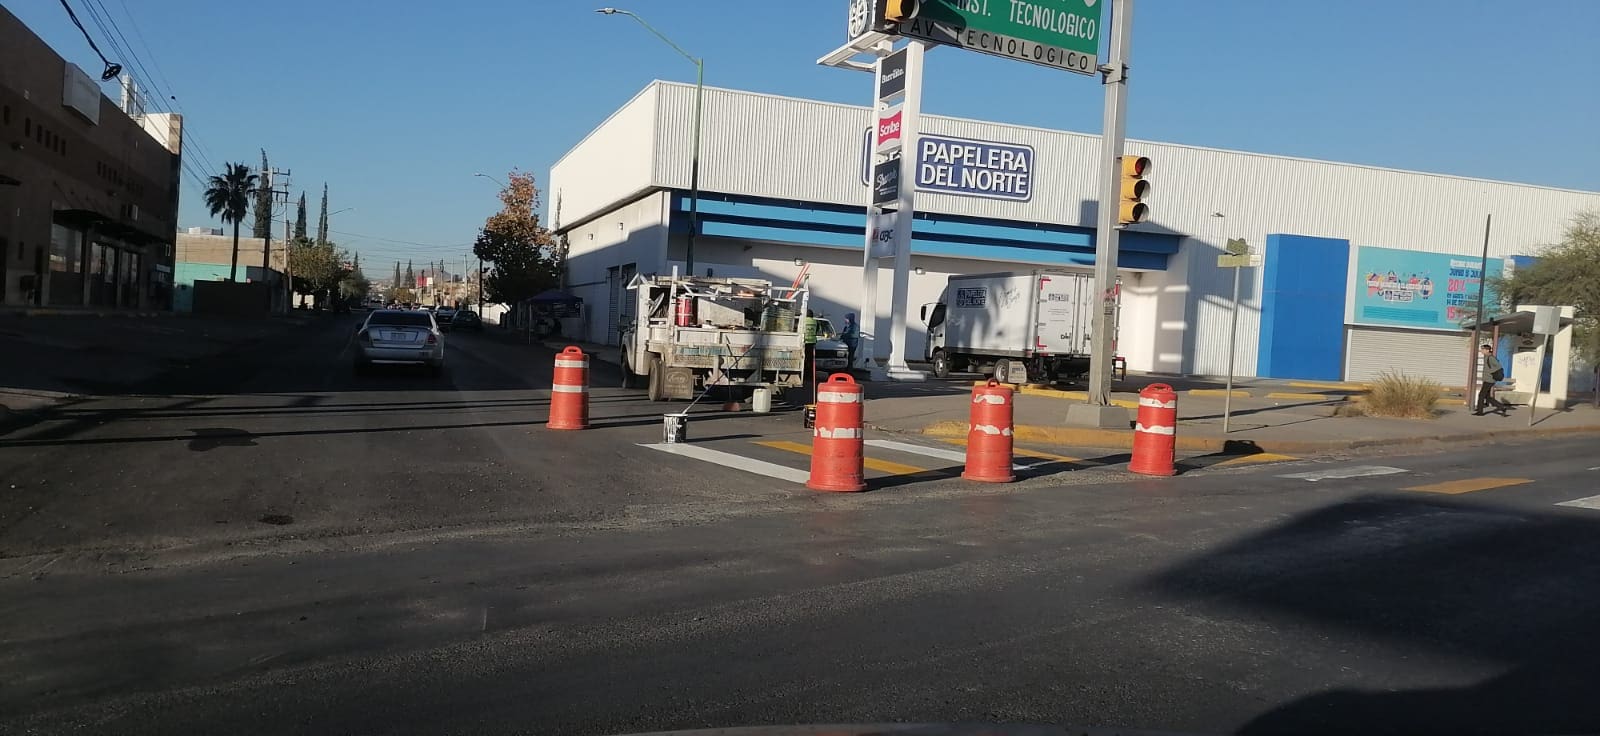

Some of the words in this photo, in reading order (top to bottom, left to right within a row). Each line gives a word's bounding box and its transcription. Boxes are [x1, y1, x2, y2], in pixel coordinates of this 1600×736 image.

[1009, 0, 1096, 41] TECNOLOGICO
[911, 19, 934, 37] AV
[954, 27, 1089, 70] TECNOLOGICO
[922, 141, 1028, 173] PAPELERA
[921, 164, 958, 187] DEL
[961, 167, 1027, 193] NORTE
